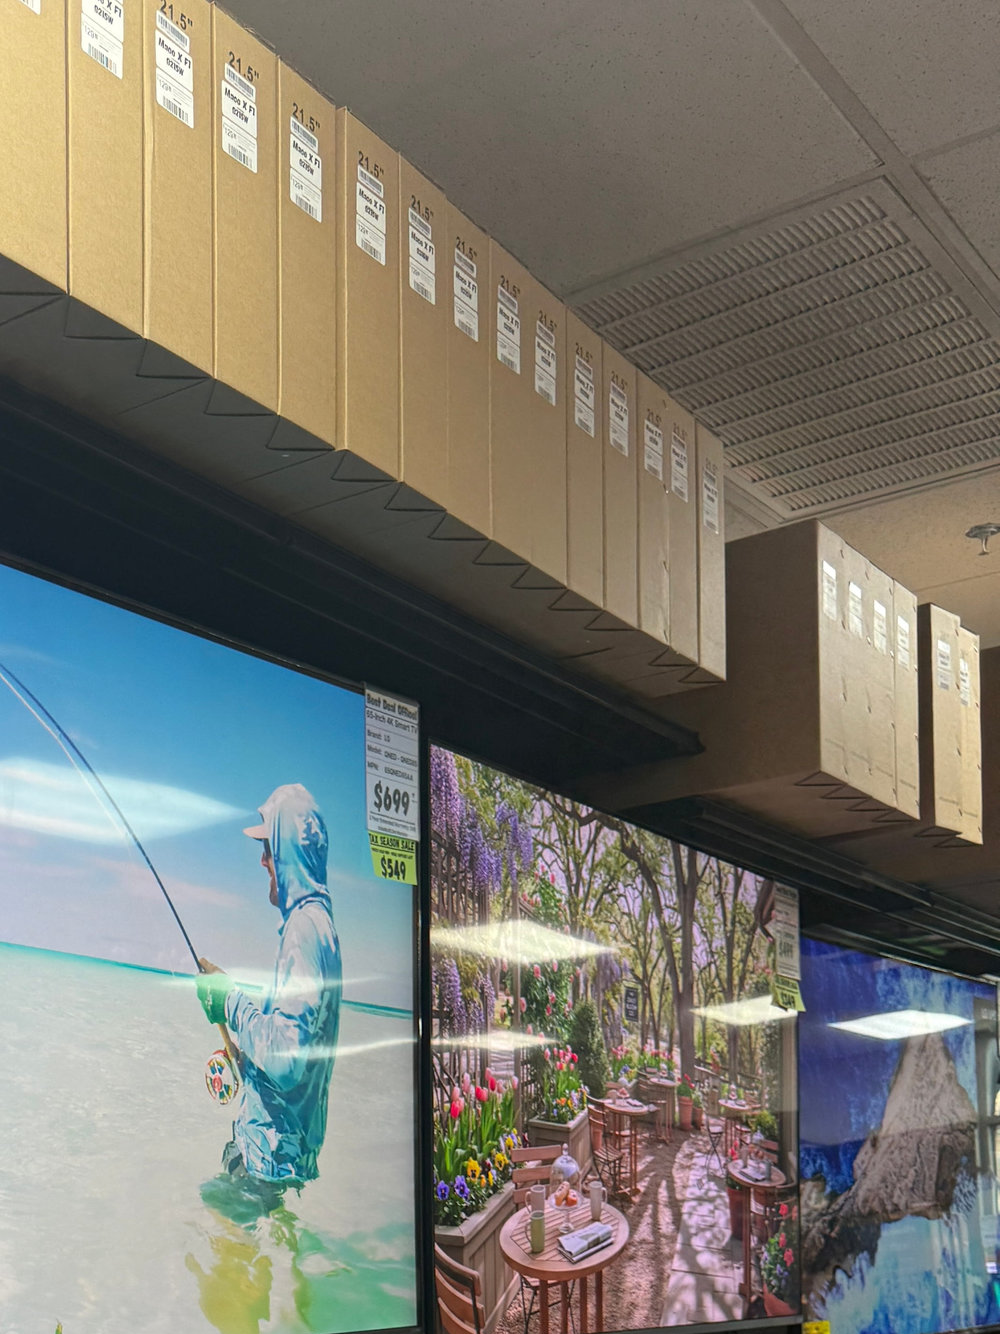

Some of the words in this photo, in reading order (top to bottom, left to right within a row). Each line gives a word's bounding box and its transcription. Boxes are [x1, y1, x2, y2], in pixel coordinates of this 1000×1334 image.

[229, 51, 259, 82] 21.5"
[293, 103, 320, 132] 21.5"
[359, 151, 384, 178] 21.5"
[411, 195, 434, 220] 21.5"
[373, 780, 410, 816] $699
[369, 833, 379, 844] TAX
[379, 835, 400, 849] SEASON
[400, 839, 414, 851] SALE
[380, 854, 406, 881] $549
